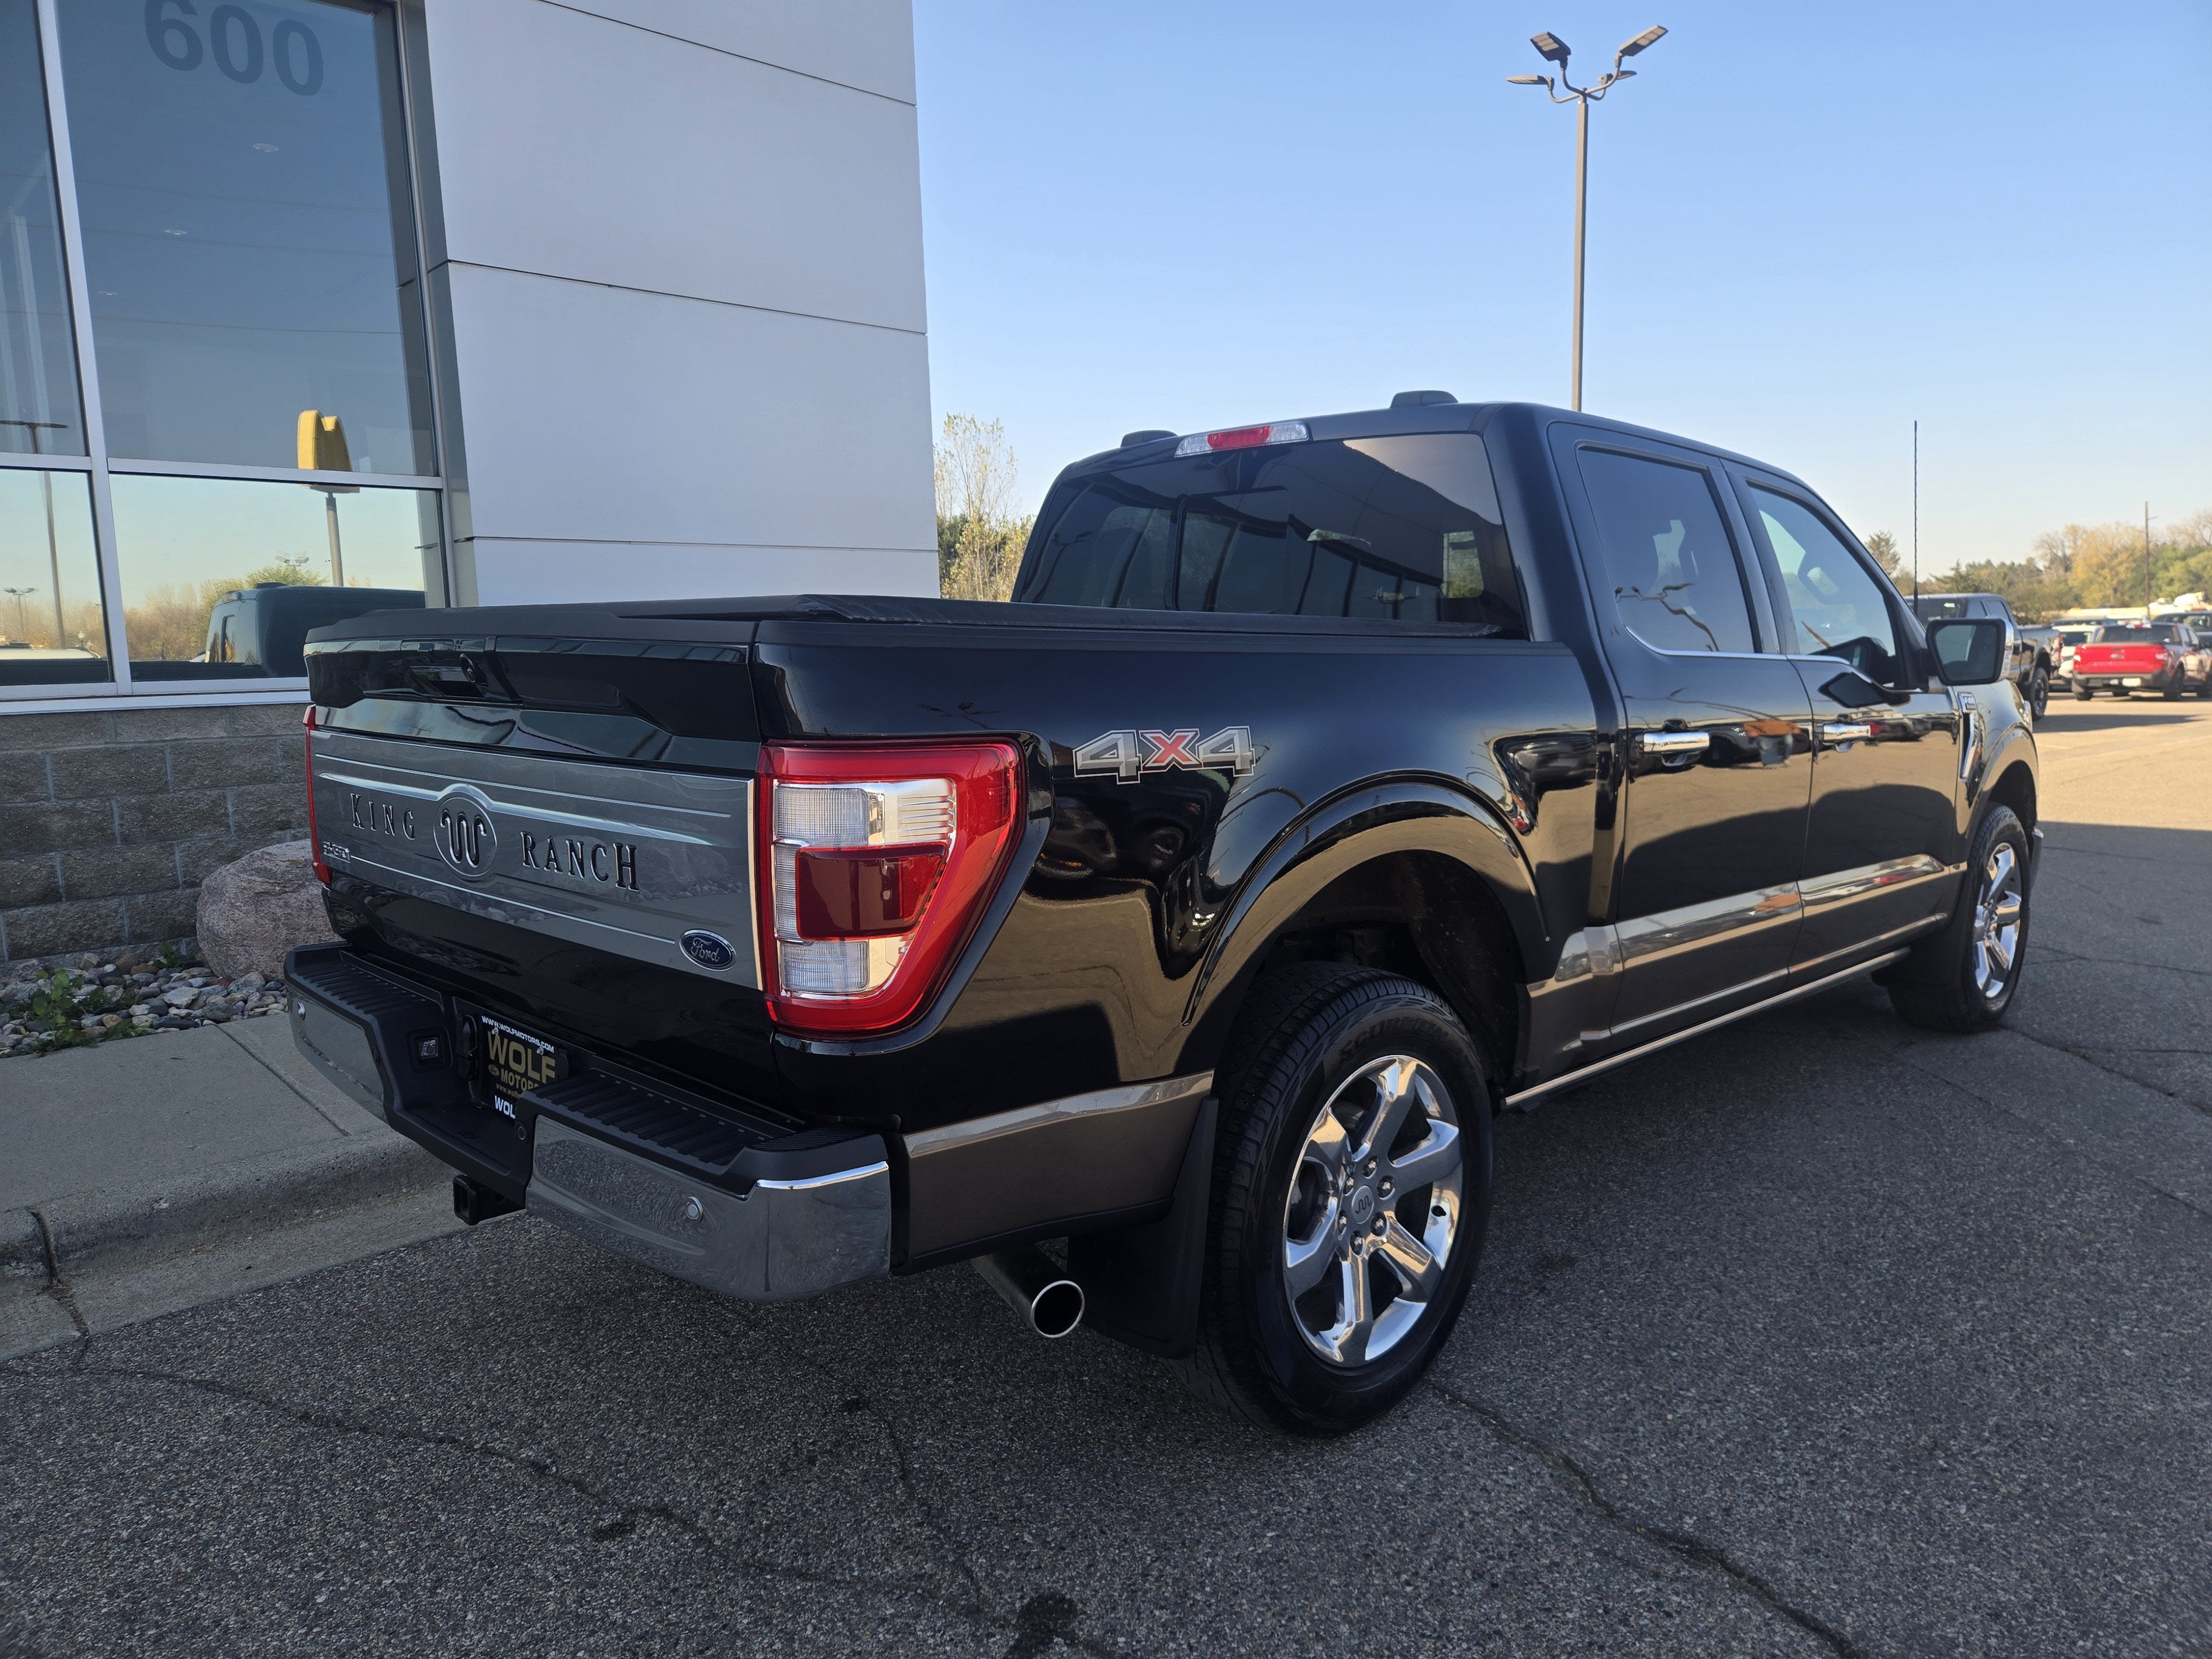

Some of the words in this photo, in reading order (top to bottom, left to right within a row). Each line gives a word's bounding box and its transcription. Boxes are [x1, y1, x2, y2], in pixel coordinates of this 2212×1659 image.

[144, 0, 324, 96] 600
[350, 792, 416, 841] KING
[520, 831, 640, 892] RANCH
[690, 937, 721, 962] Ford
[487, 1031, 555, 1084] WOLF
[494, 1095, 517, 1119] WOL
